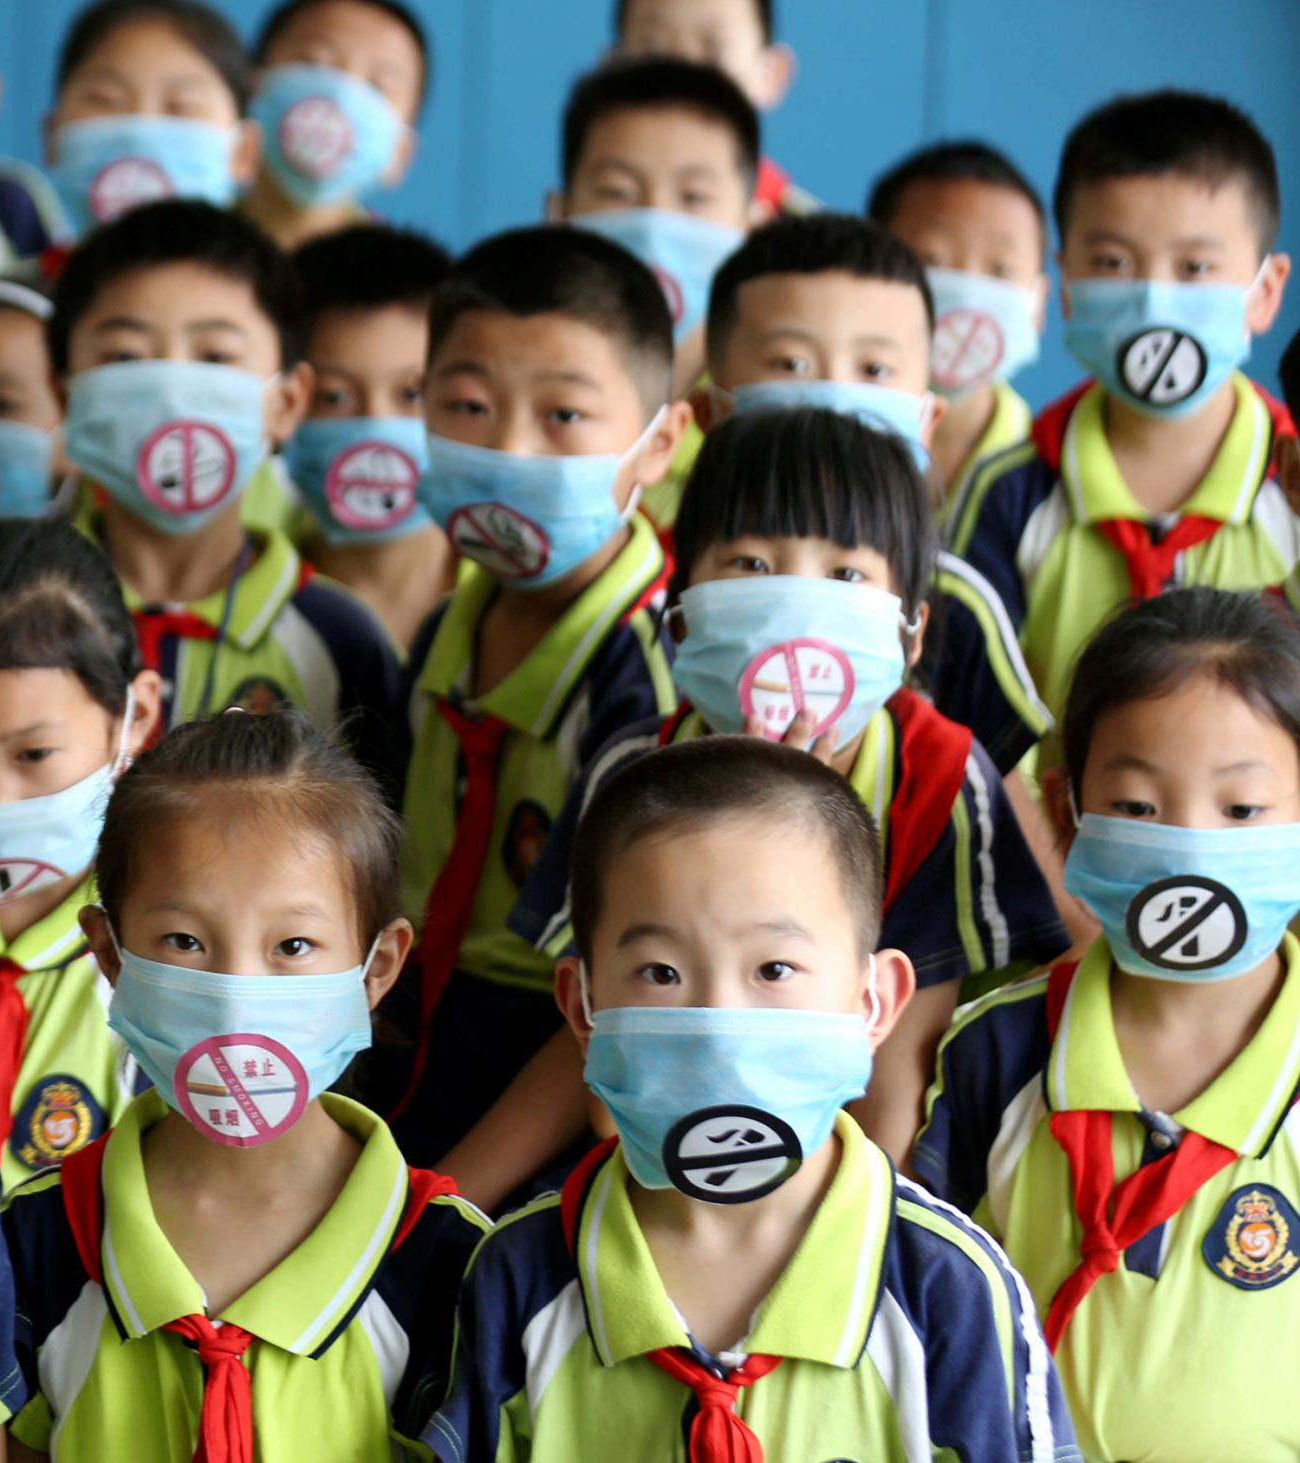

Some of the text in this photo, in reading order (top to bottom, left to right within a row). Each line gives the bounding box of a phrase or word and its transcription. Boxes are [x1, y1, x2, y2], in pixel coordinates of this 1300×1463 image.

[243, 1058, 276, 1078] 禁止
[214, 1056, 265, 1127] NO SMOKING
